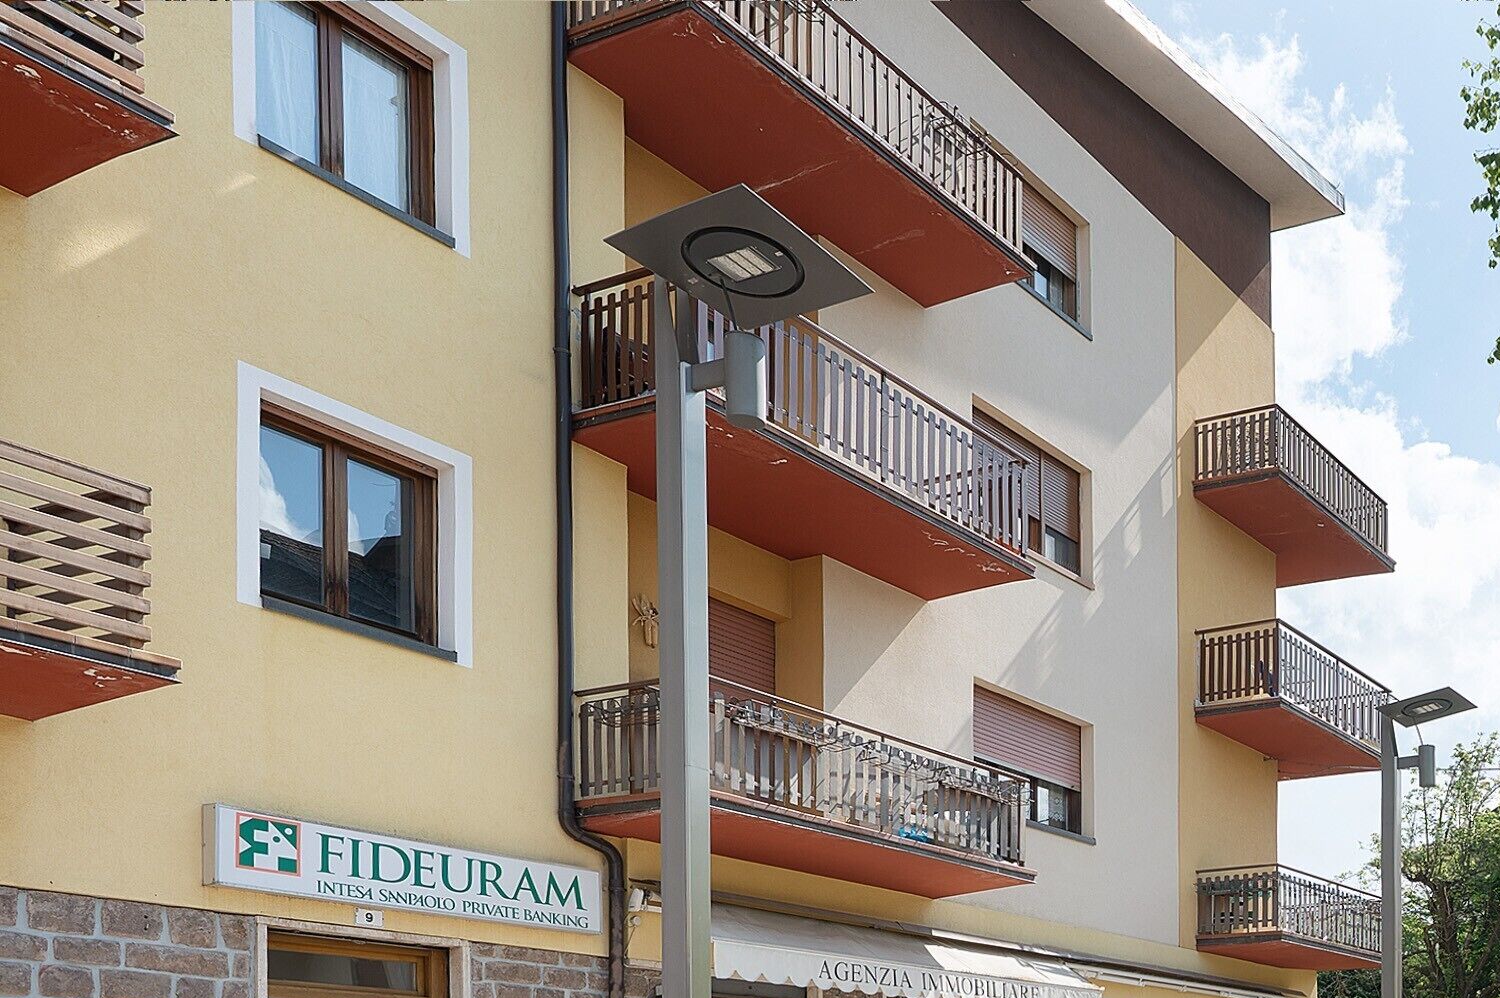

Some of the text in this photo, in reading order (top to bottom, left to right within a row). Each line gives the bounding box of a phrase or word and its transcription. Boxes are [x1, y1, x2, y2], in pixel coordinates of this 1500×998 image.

[316, 832, 588, 911] FIDEURAM
[316, 880, 589, 929] INTESA SANPAOLO PRIVATE BANKING
[365, 912, 374, 922] 9
[819, 960, 913, 989] AGENZIA
